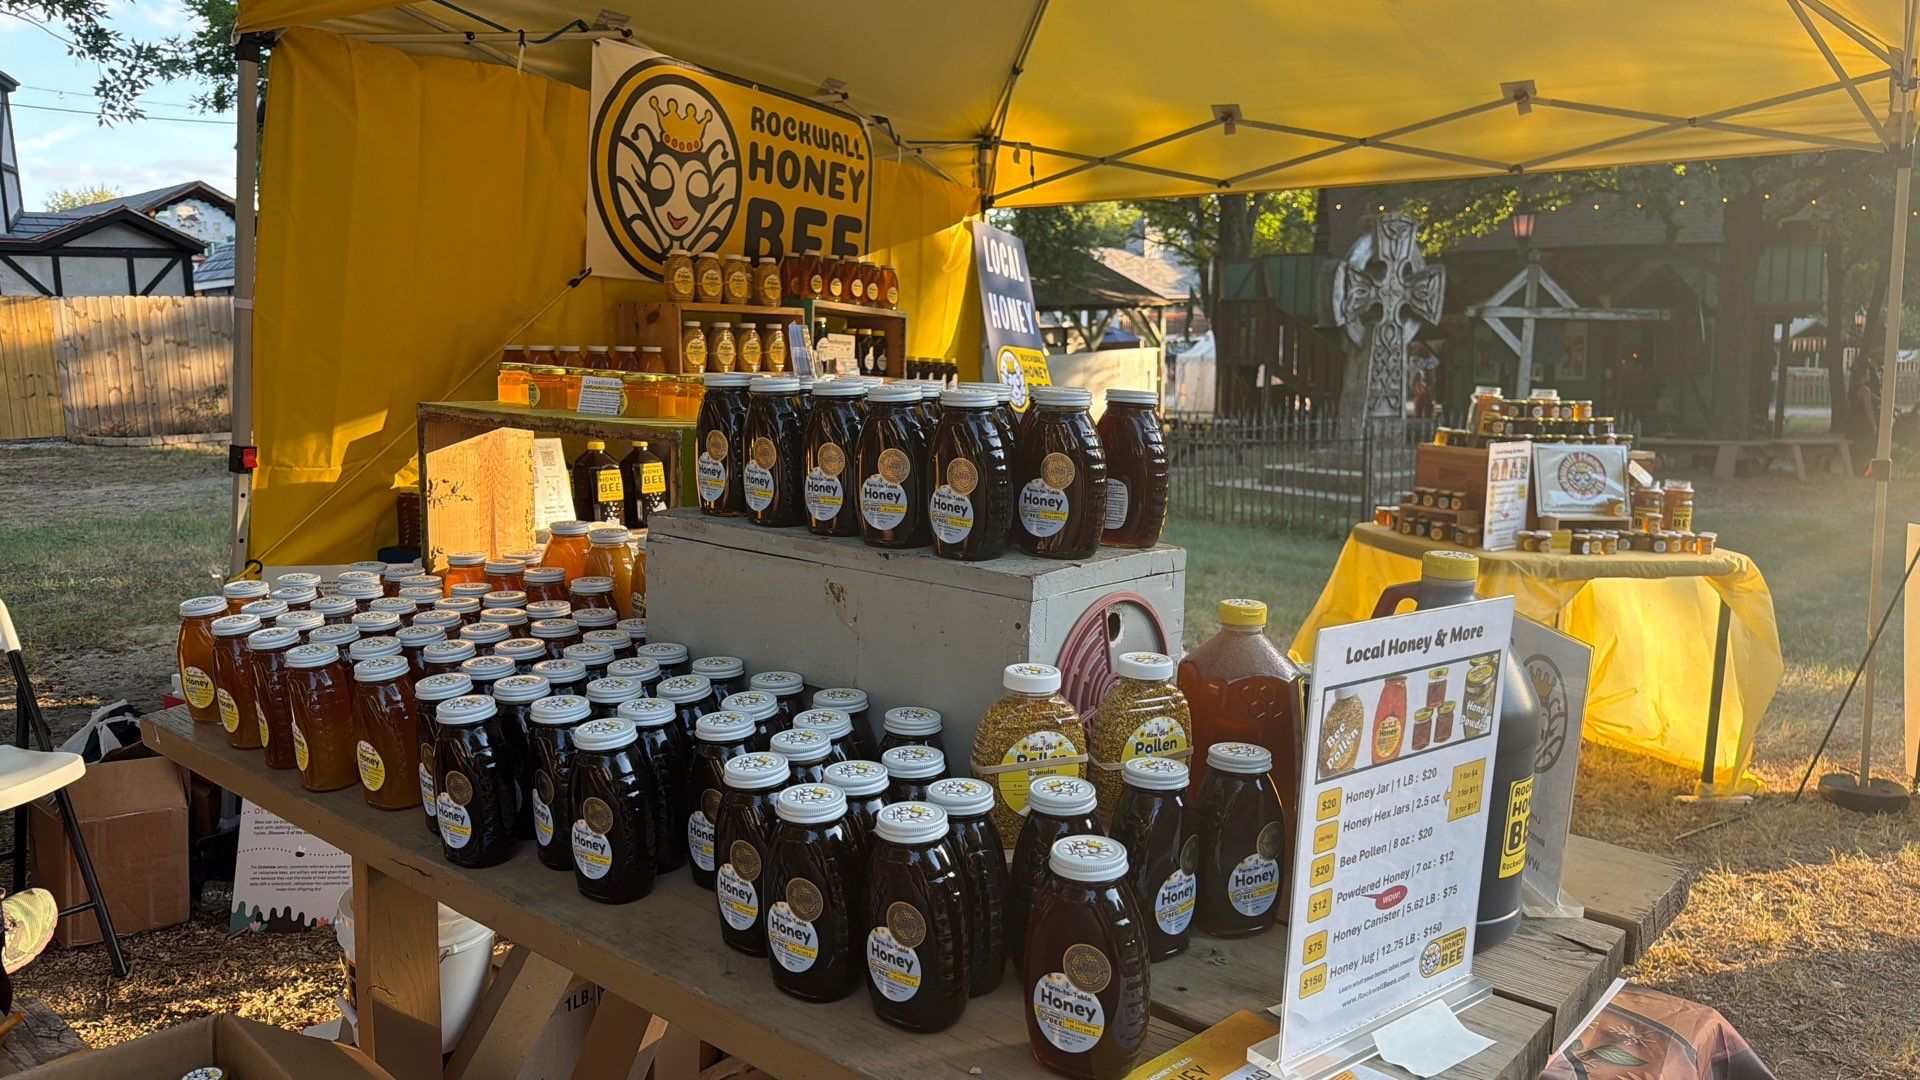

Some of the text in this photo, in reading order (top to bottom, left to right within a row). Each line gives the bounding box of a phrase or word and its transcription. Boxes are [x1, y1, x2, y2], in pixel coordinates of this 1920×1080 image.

[751, 106, 864, 160] ROCKWALL
[749, 142, 865, 204] HONEY
[744, 198, 862, 258] BEE
[983, 235, 1024, 282] LOCAL
[988, 292, 1034, 335] HONEY
[1024, 366, 1047, 379] HONEY
[644, 475, 664, 485] BEE
[699, 464, 722, 477] Honey
[601, 483, 621, 493] BEE
[745, 474, 770, 489] Honey
[807, 480, 838, 496] Honey
[864, 487, 901, 504] Honey
[1023, 492, 1064, 511] Honey
[933, 496, 968, 515] Honey
[1346, 625, 1484, 664] Local Honey & More
[186, 677, 209, 689] Honey
[1467, 701, 1490, 716] Honey
[1379, 728, 1398, 737] Honey
[1459, 715, 1488, 731] Powder
[1327, 723, 1346, 748] Bee
[1135, 738, 1177, 756] Pollen
[1327, 728, 1358, 769] Pollen
[359, 751, 379, 769] Honey
[1028, 768, 1057, 776] Granules
[1346, 787, 1375, 805] Honey
[1376, 783, 1391, 795] Jar
[1422, 767, 1438, 782] $20
[1322, 798, 1337, 812] $20
[1343, 794, 1440, 833] Honey Hex Jars 2.5 oz
[1512, 797, 1530, 817] HO
[438, 805, 465, 826] Honey
[691, 821, 714, 843] Hone
[574, 832, 606, 855] Honey
[1340, 855, 1357, 868] Bee
[1359, 843, 1387, 861] Pollen
[1393, 838, 1398, 849] 8
[1418, 827, 1433, 842] $20
[1239, 862, 1273, 873] Farm-to-Table
[1315, 865, 1330, 879] $20
[1337, 877, 1381, 903] Powdered
[1383, 868, 1410, 888] Honey
[1440, 851, 1454, 866] $12
[1165, 877, 1192, 891] Farm-to-Table
[1235, 869, 1275, 888] Honey
[720, 879, 752, 904] Honey
[1162, 883, 1194, 906] Honey
[1383, 890, 1401, 904] WOW!
[1313, 899, 1327, 913] $12
[1333, 924, 1362, 943] Honey
[1364, 909, 1400, 931] Canister
[1407, 898, 1424, 914] 5.62
[1443, 885, 1458, 900] $75
[771, 915, 811, 945] Honey
[1308, 940, 1322, 955] $75
[1330, 960, 1359, 979] Honey
[1360, 951, 1375, 968] Jug
[1382, 941, 1404, 957] 12.75
[1423, 922, 1442, 938] $150
[1442, 937, 1464, 952] HONEY
[871, 942, 913, 973] Honey
[1441, 946, 1463, 967] BEE
[1303, 974, 1323, 990] $150
[1045, 982, 1091, 1002] Farm-to-Table
[1041, 988, 1096, 1022] Honey
